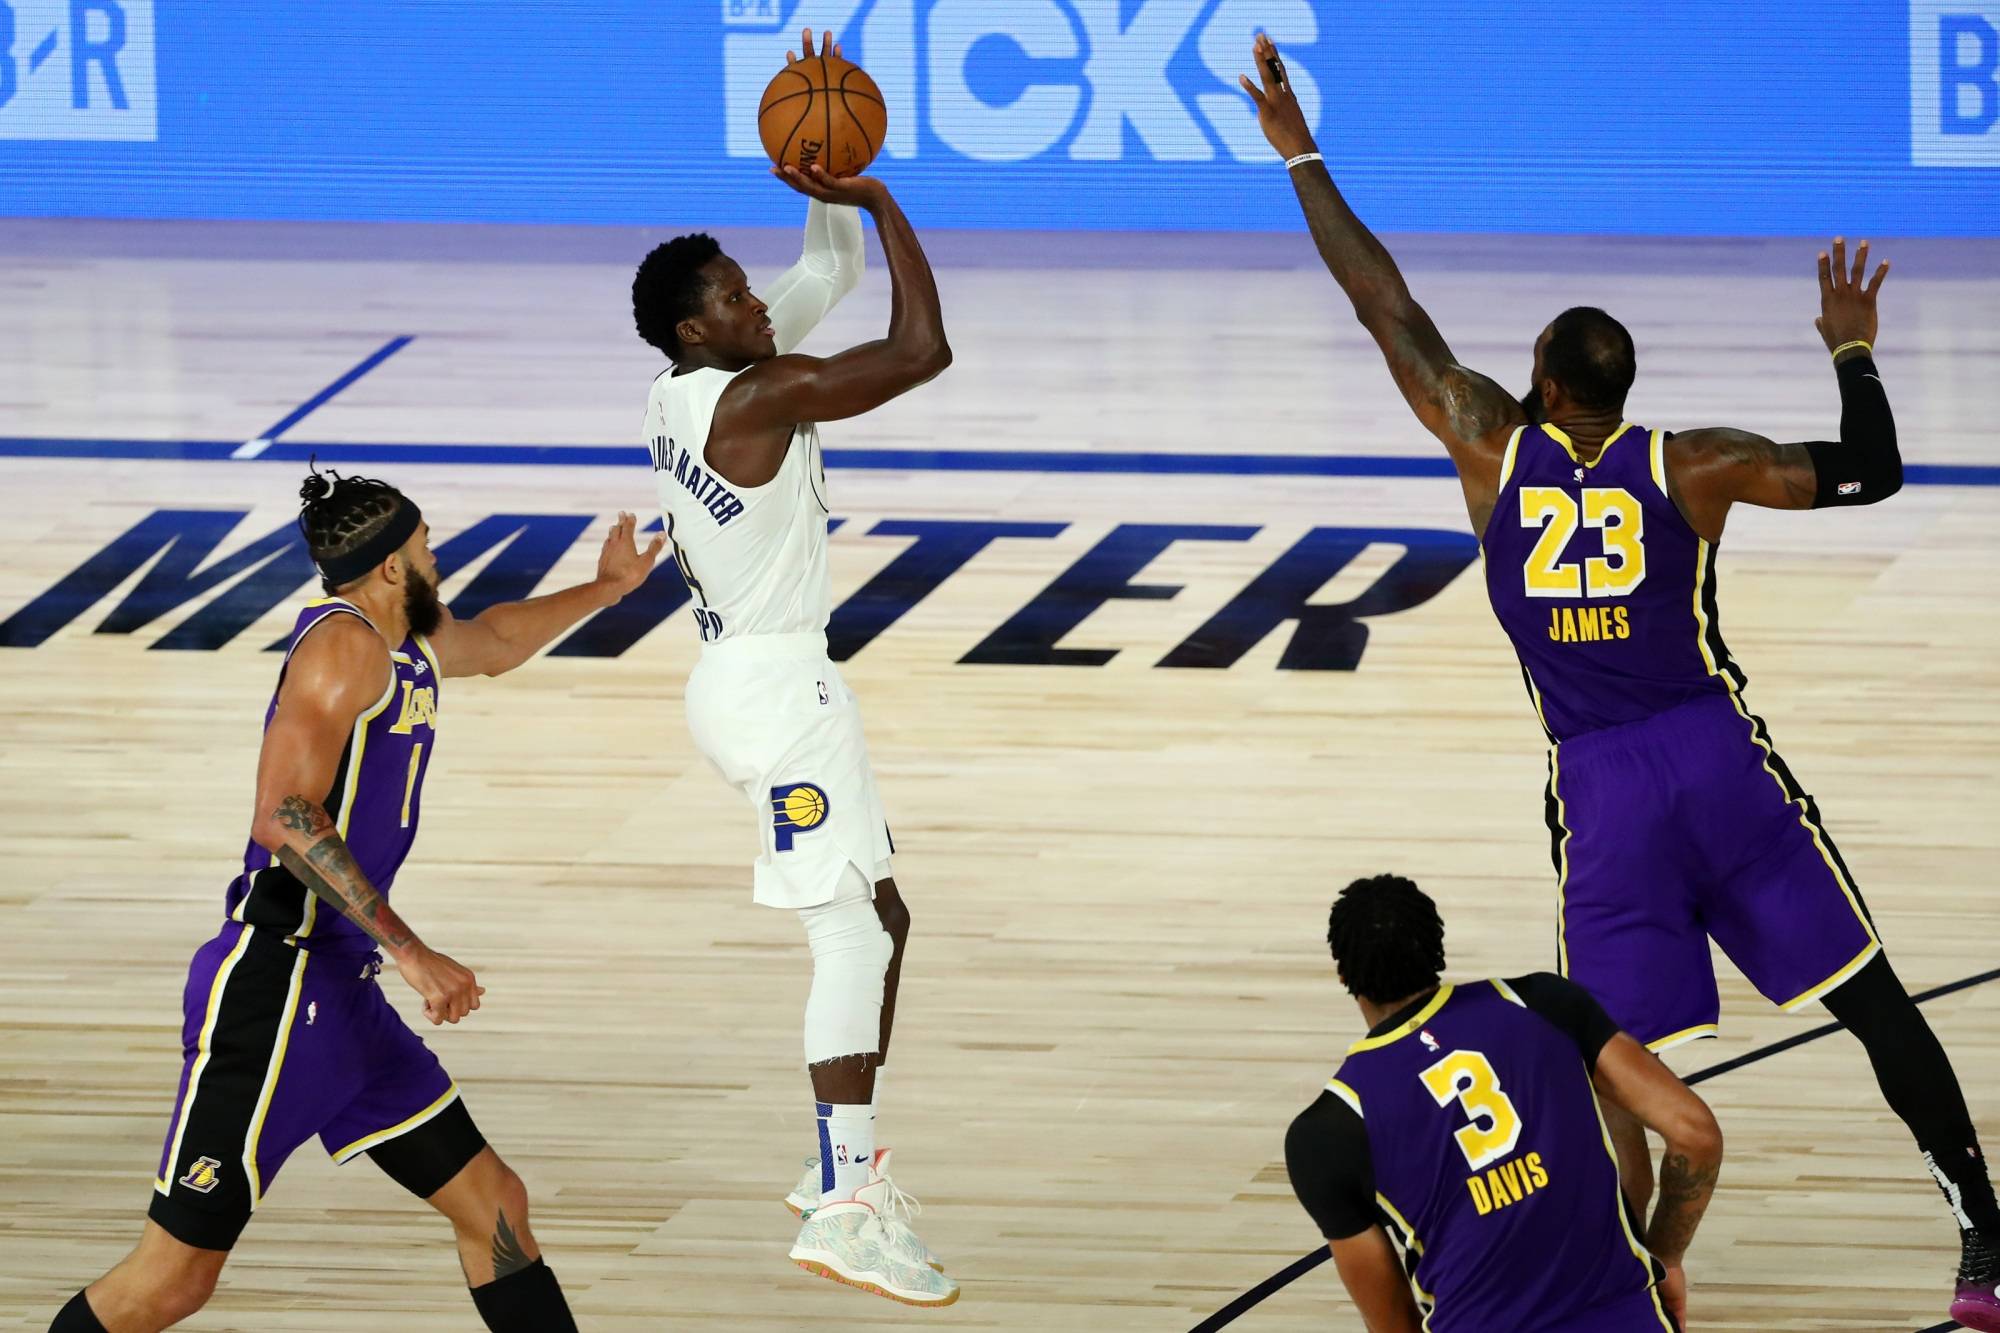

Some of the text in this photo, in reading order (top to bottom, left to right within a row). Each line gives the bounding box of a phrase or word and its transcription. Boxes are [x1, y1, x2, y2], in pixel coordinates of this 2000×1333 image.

[674, 447, 745, 527] MATTER
[1518, 486, 1647, 599] 23
[1548, 605, 1632, 643] JAMES
[400, 742, 423, 828] 1
[1418, 1049, 1523, 1172] 3
[1465, 1151, 1550, 1217] DAVIS
